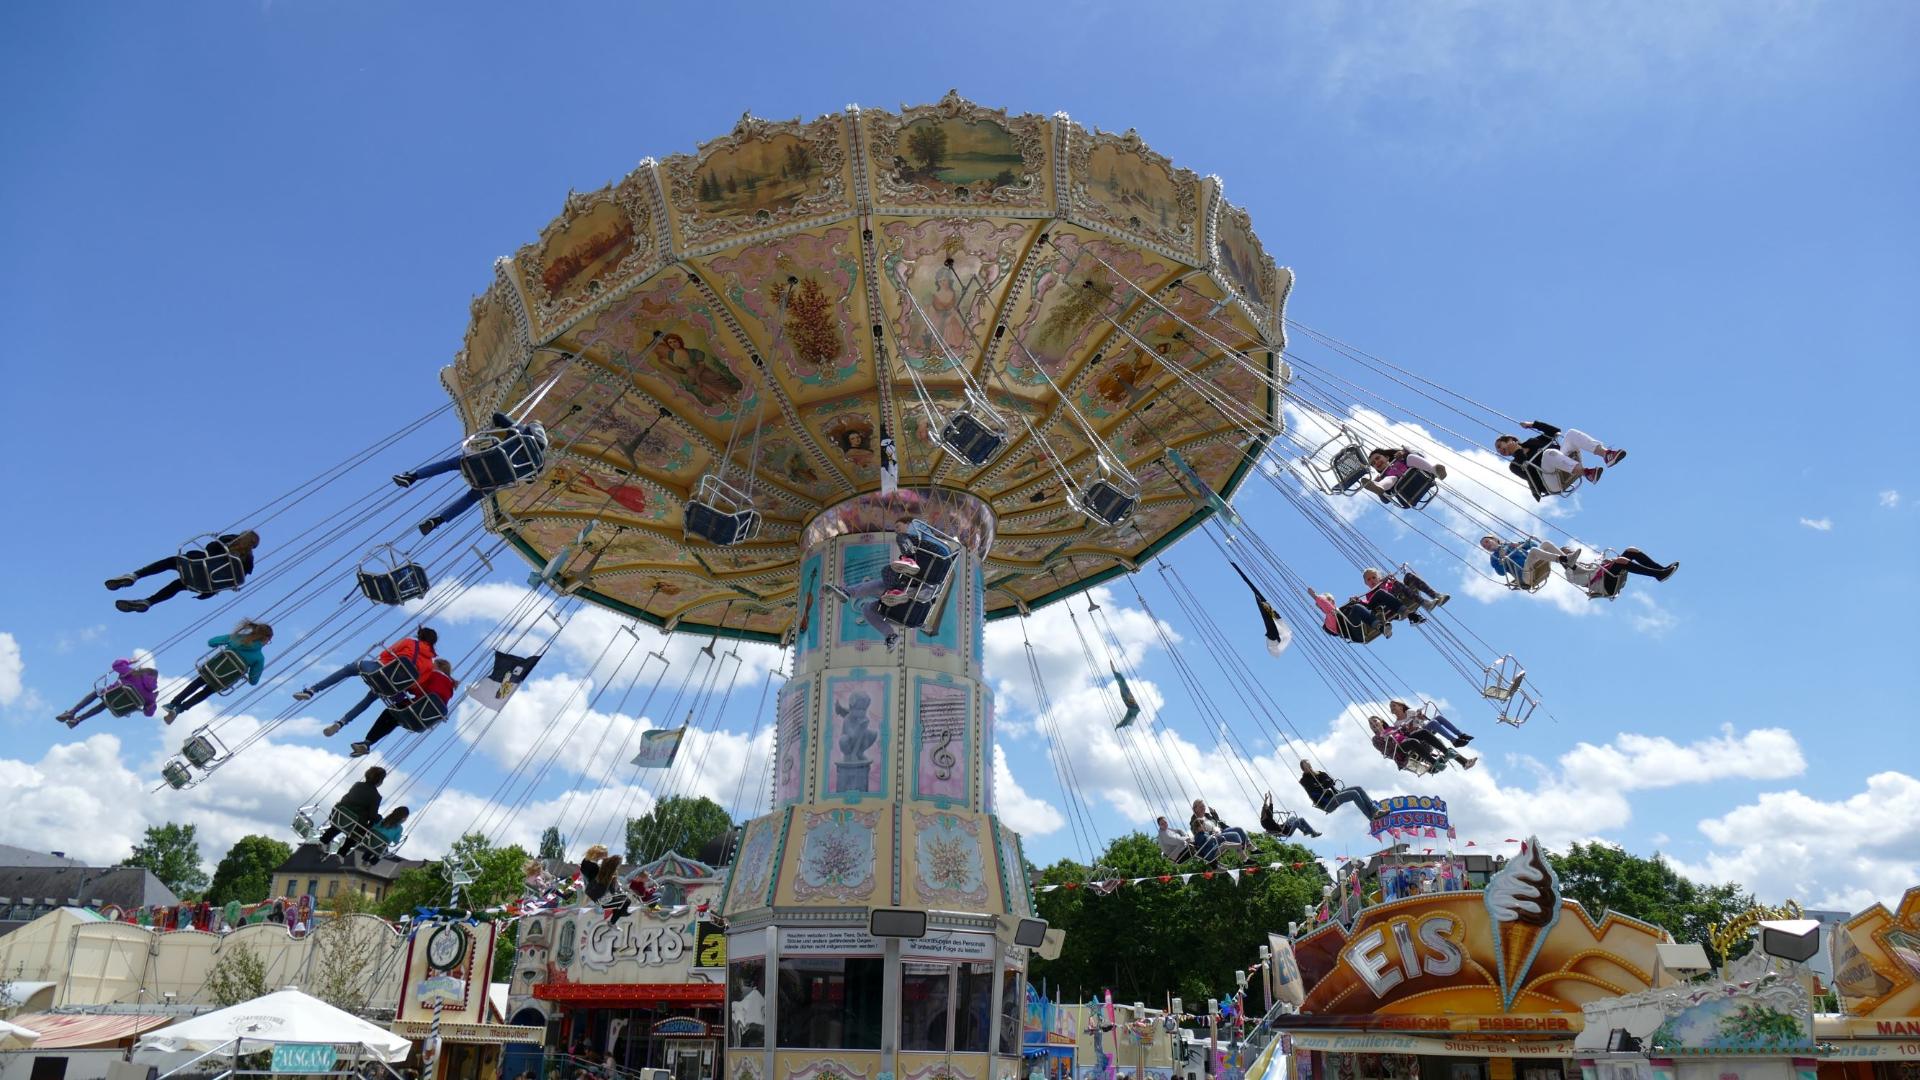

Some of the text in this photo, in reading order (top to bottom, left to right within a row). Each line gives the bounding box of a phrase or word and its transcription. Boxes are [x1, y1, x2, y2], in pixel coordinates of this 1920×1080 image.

[1372, 812, 1446, 833] RUTSCHE
[590, 920, 685, 965] GLAS
[1344, 916, 1462, 999] EIS
[455, 1027, 476, 1036] Pizza
[489, 1029, 529, 1038] Maiskolben
[1478, 1017, 1569, 1030] EISBECHER
[1444, 1041, 1507, 1054] Slush-Eis
[1518, 1044, 1550, 1054] klein
[279, 1048, 330, 1067] AUSGANG
